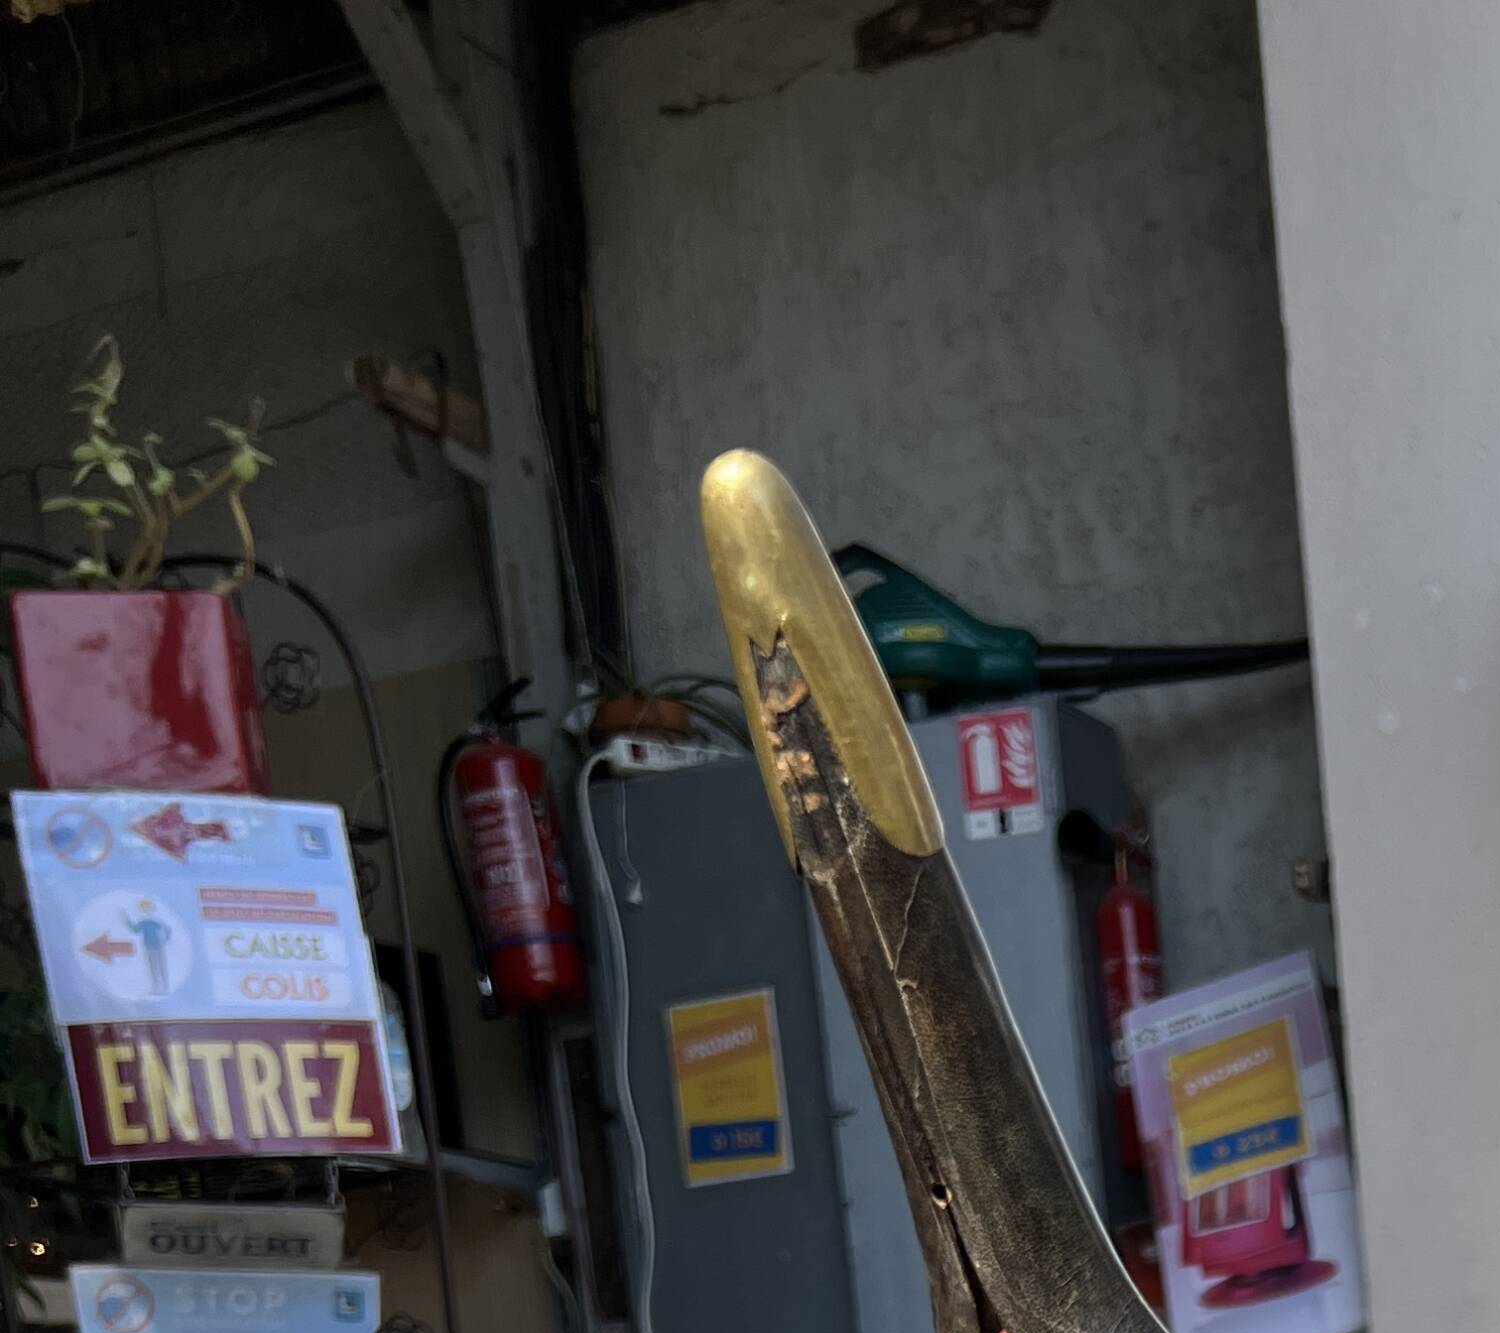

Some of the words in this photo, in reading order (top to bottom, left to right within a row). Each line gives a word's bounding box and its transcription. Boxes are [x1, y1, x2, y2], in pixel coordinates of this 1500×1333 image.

[223, 930, 329, 961] CAISSE
[239, 971, 330, 1002] COLIS
[96, 1038, 376, 1146] ENTREZ
[149, 1232, 316, 1258] OUVERT
[173, 1285, 287, 1315] STOP
